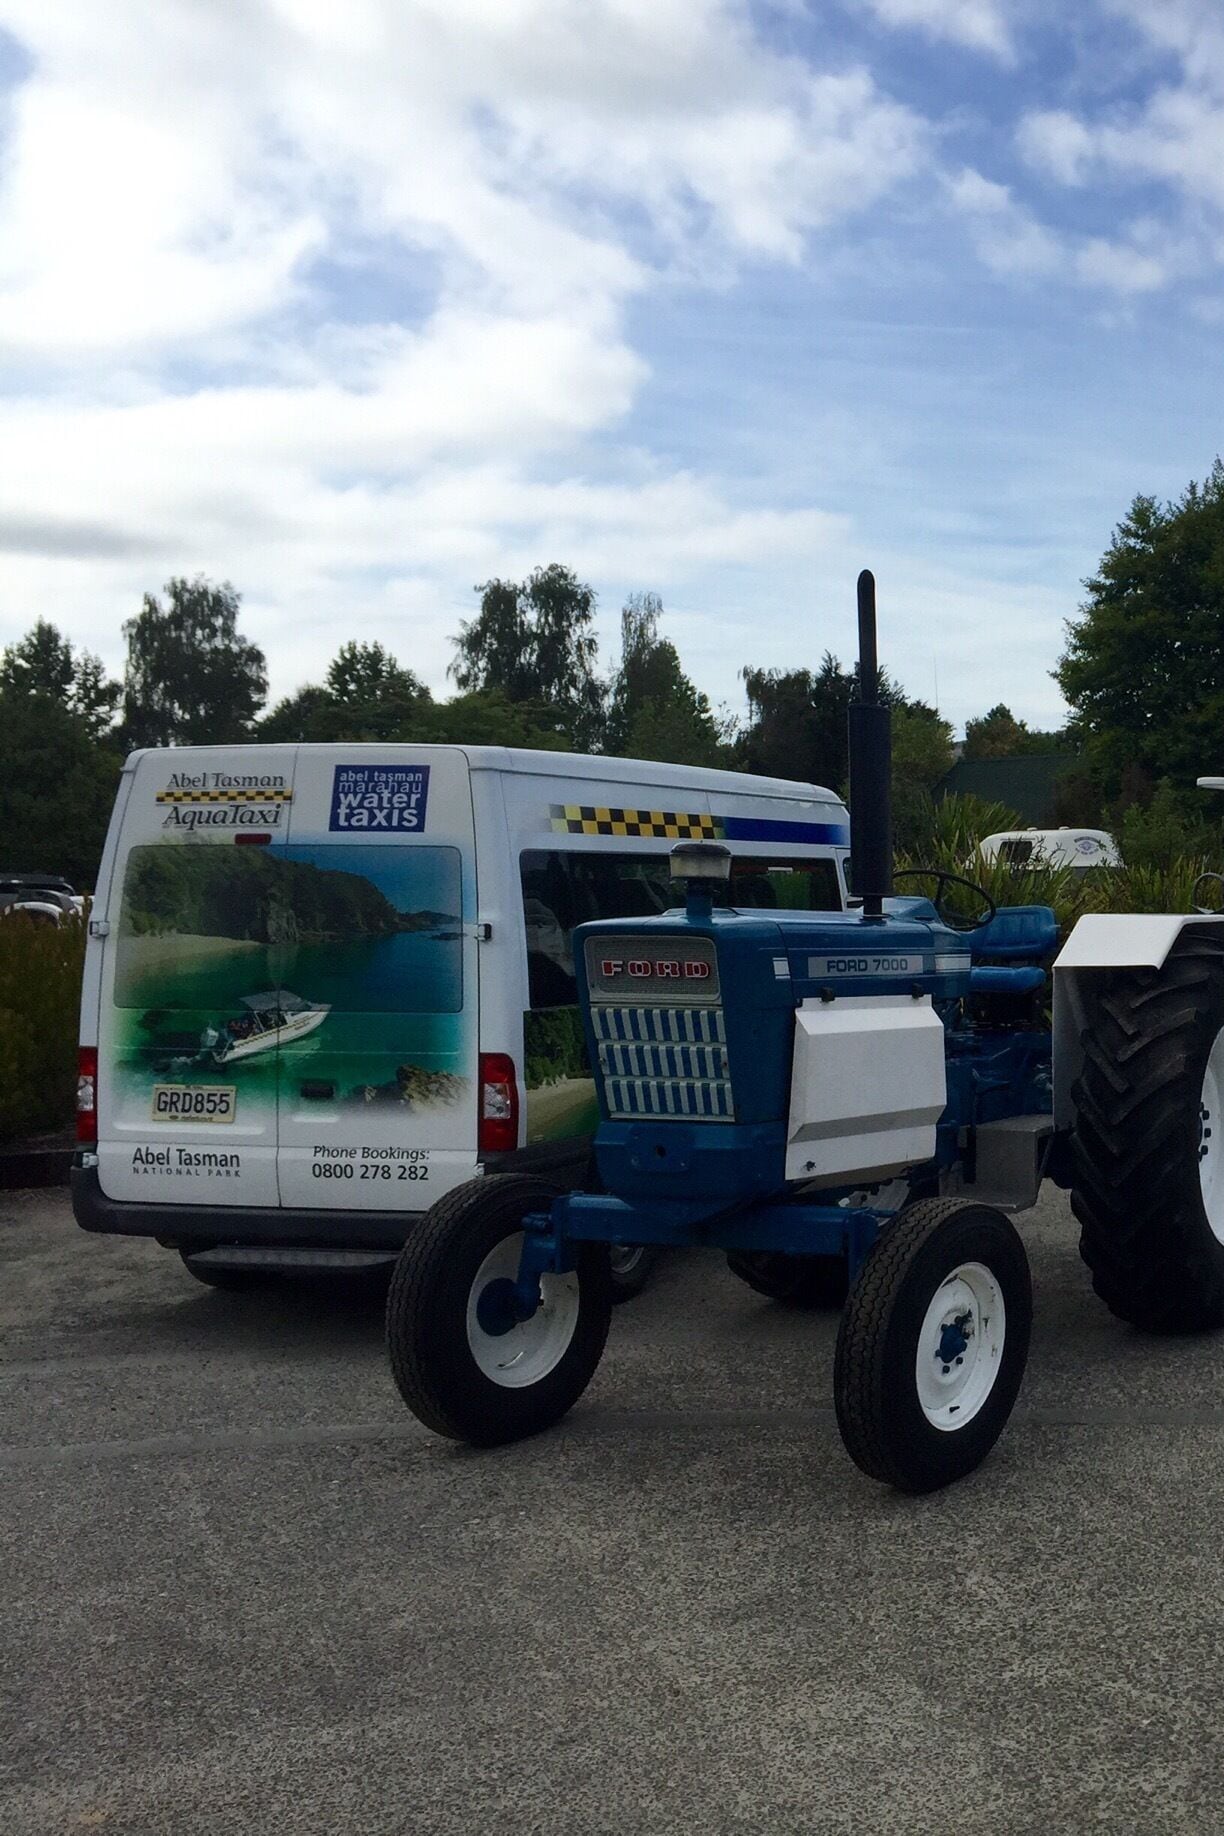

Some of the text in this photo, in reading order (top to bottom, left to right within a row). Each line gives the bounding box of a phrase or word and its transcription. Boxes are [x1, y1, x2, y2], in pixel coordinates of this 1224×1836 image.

[167, 772, 284, 788] Abel Tasman
[340, 770, 422, 781] abel tasman
[339, 780, 422, 793] marahau
[339, 790, 420, 808] water
[162, 803, 281, 831] AquaTaxi
[337, 804, 418, 827] taxis
[602, 960, 709, 978] FORD
[826, 959, 908, 973] FORD 7000
[157, 1091, 230, 1114] GRD855
[132, 1147, 241, 1168] Abel Tasman
[313, 1146, 430, 1163] Phone Bookings:
[133, 1167, 241, 1178] NATIONAL PARK
[312, 1163, 429, 1181] 0800 278 282
